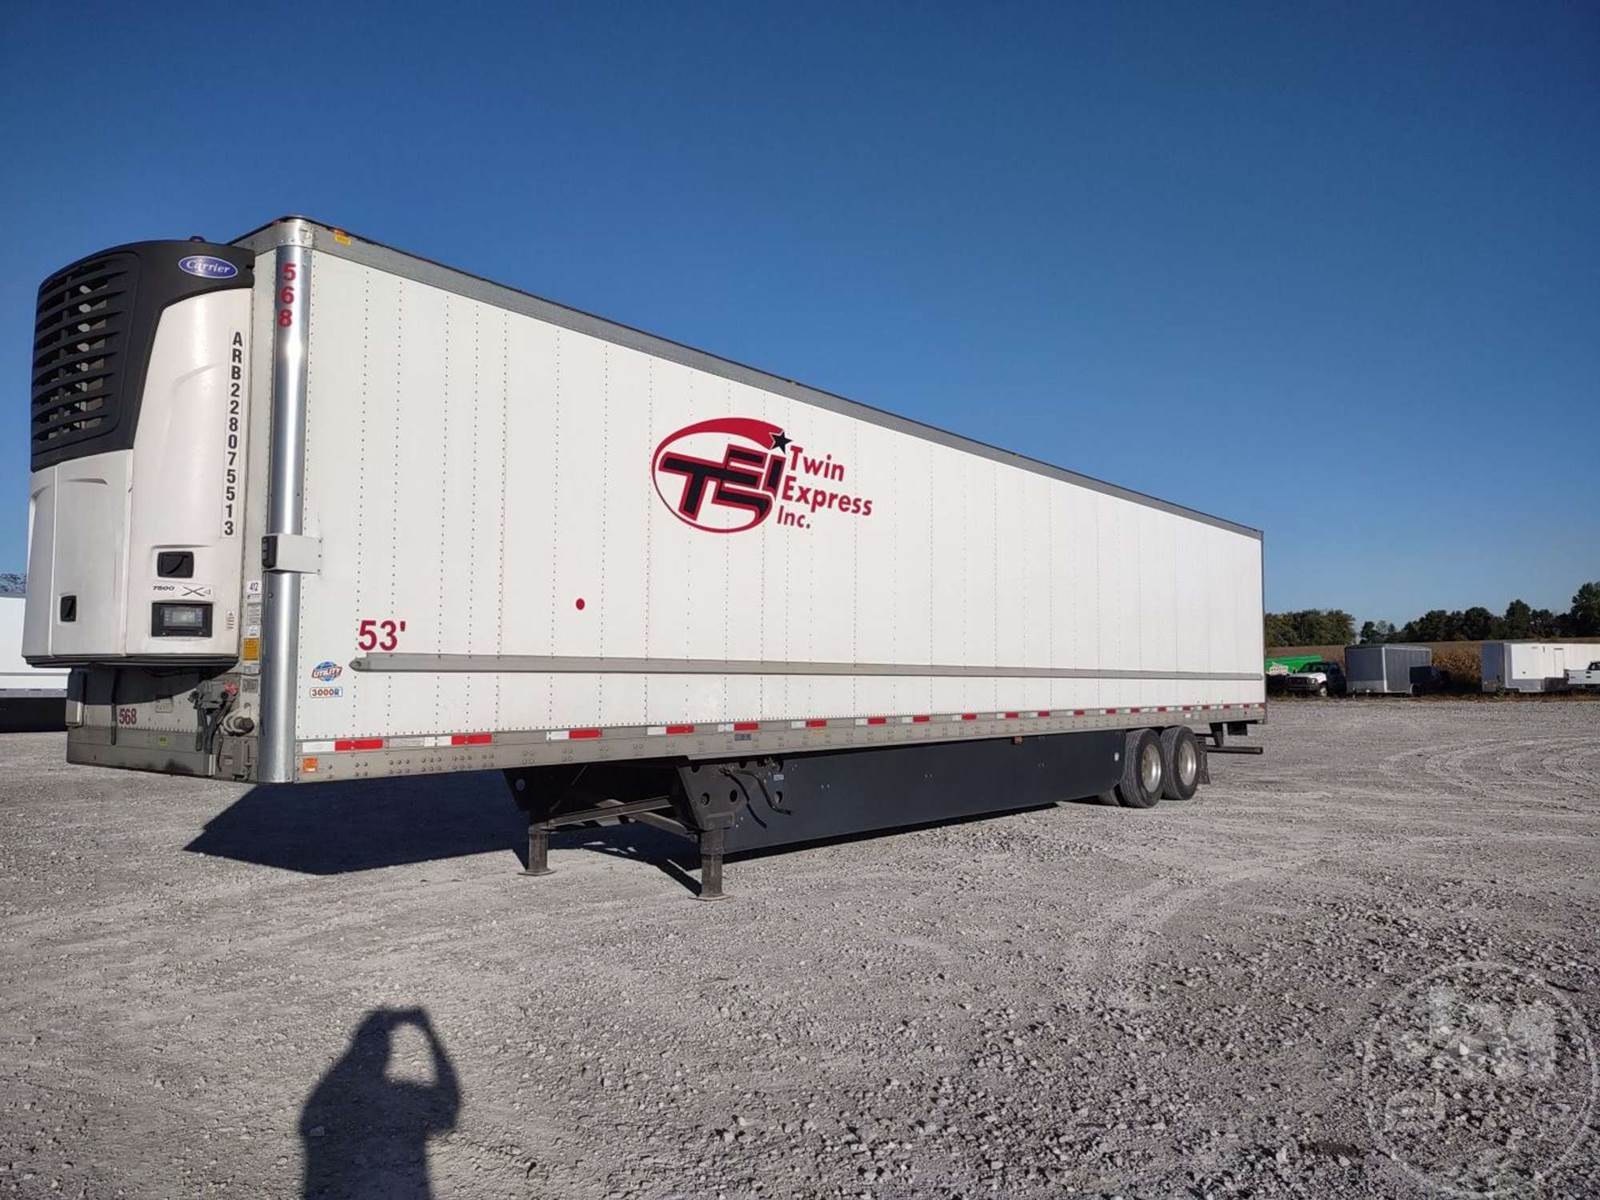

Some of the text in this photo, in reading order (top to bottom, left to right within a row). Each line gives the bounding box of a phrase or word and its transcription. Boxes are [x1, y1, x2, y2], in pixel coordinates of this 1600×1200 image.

[186, 259, 231, 273] Carrier
[280, 263, 296, 327] 568
[224, 331, 243, 536] ARB228075513
[790, 445, 845, 482] Twin
[782, 475, 873, 516] Express
[777, 506, 811, 529] Inc.
[358, 620, 406, 651] 53'
[119, 708, 137, 725] 568
